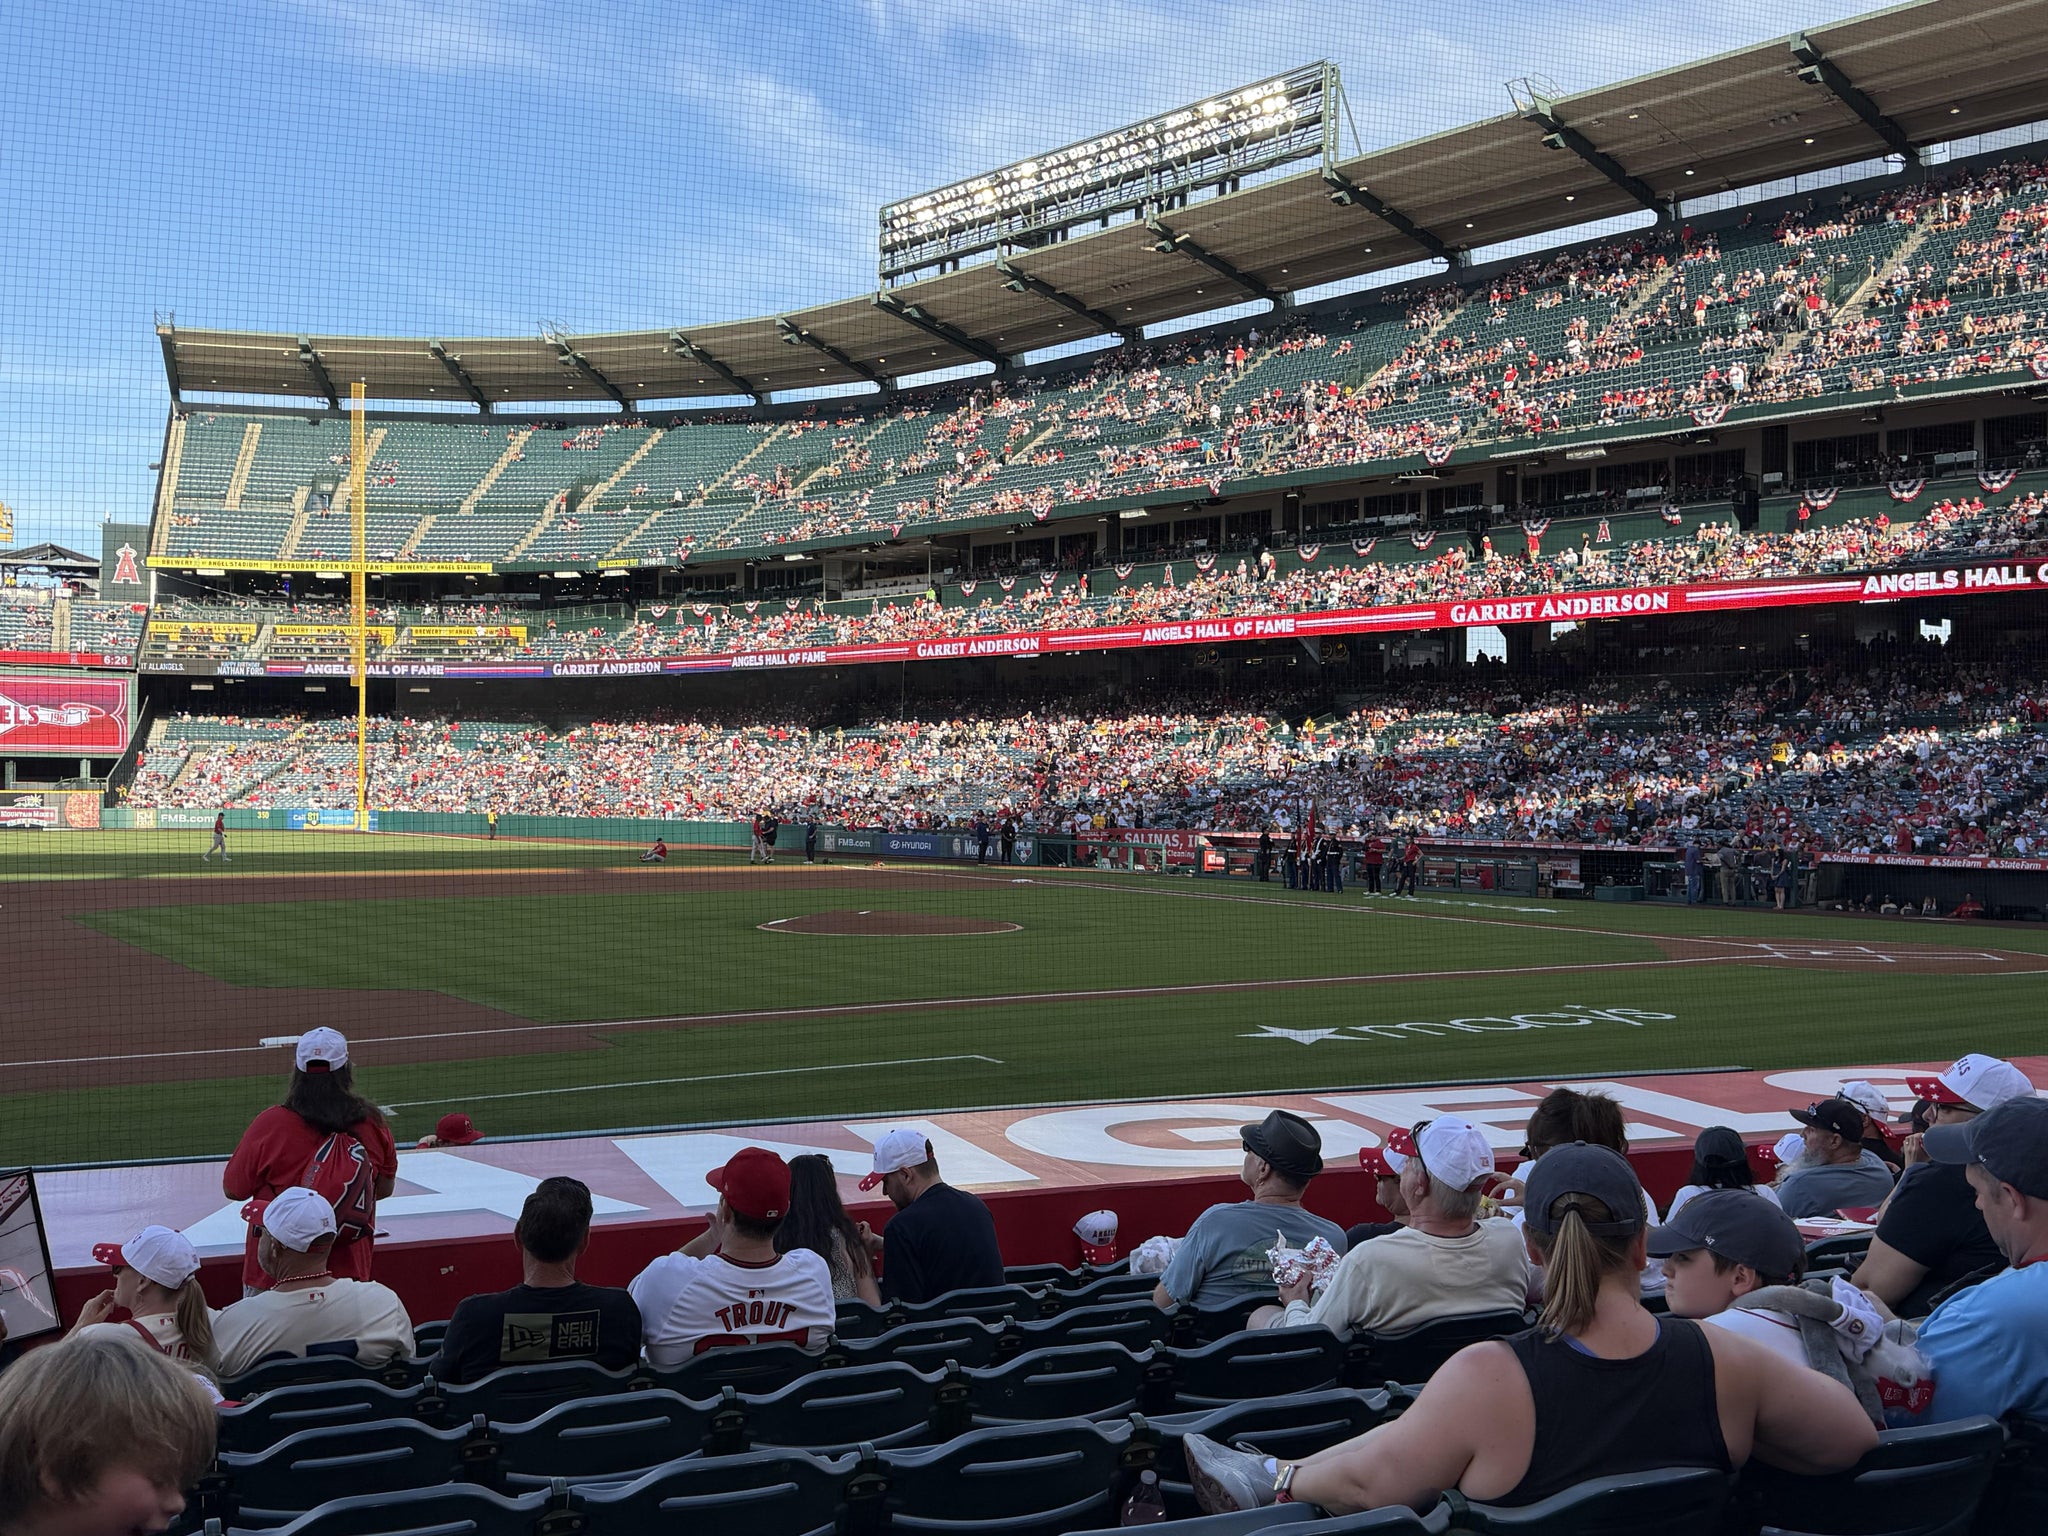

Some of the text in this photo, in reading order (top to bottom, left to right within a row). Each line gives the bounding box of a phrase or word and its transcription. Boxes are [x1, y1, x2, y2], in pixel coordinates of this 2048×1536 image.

[1863, 570, 1958, 594] ANGELS
[1965, 565, 2031, 588] HALL
[1450, 592, 1669, 623] GARRET ANDERSON
[1142, 618, 1295, 642] ANGELS HALL OF FAME
[917, 637, 1040, 657] GARRET ANDERSON
[104, 655, 128, 665] 6:26
[732, 651, 826, 667] ANGELS HALL OF FAME
[217, 666, 264, 675] NATHAN FORD
[305, 664, 444, 675] ANGELS ALL OF FAME
[552, 661, 661, 676] GARRET ANDERSON
[161, 813, 215, 823] FMB.com
[838, 838, 871, 848] FMB.com
[901, 841, 932, 850] HYUNDAI
[1124, 833, 1184, 850] SALINAS,
[1167, 850, 1195, 859] Cleaning
[714, 1301, 797, 1332] TROUT
[559, 1320, 593, 1335] NEW
[557, 1334, 592, 1349] ERA
